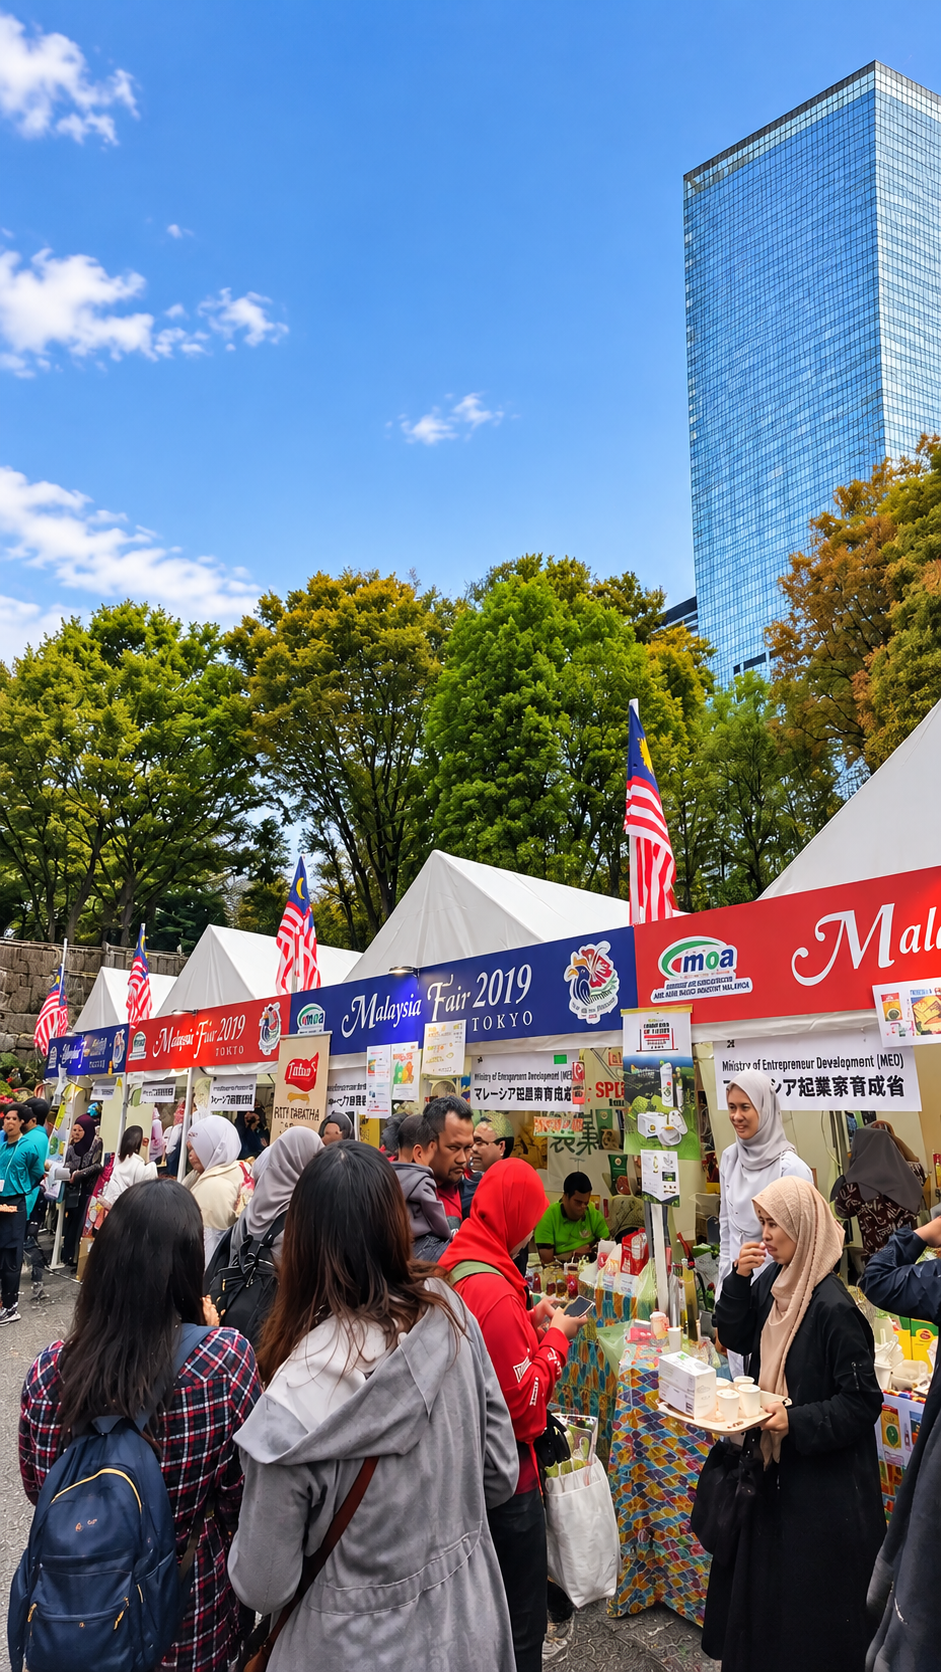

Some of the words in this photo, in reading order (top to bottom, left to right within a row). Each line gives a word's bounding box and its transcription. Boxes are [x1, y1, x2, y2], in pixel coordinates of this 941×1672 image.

[791, 903, 941, 986] Mal
[683, 949, 734, 973] moa
[341, 993, 422, 1039] Malaysia
[427, 974, 471, 1022] Fair
[472, 963, 532, 1009] 2019
[216, 1014, 246, 1042] 2019
[472, 1010, 533, 1032] TOKYO
[752, 1061, 761, 1071] of
[762, 1059, 815, 1072] Entrepreneur
